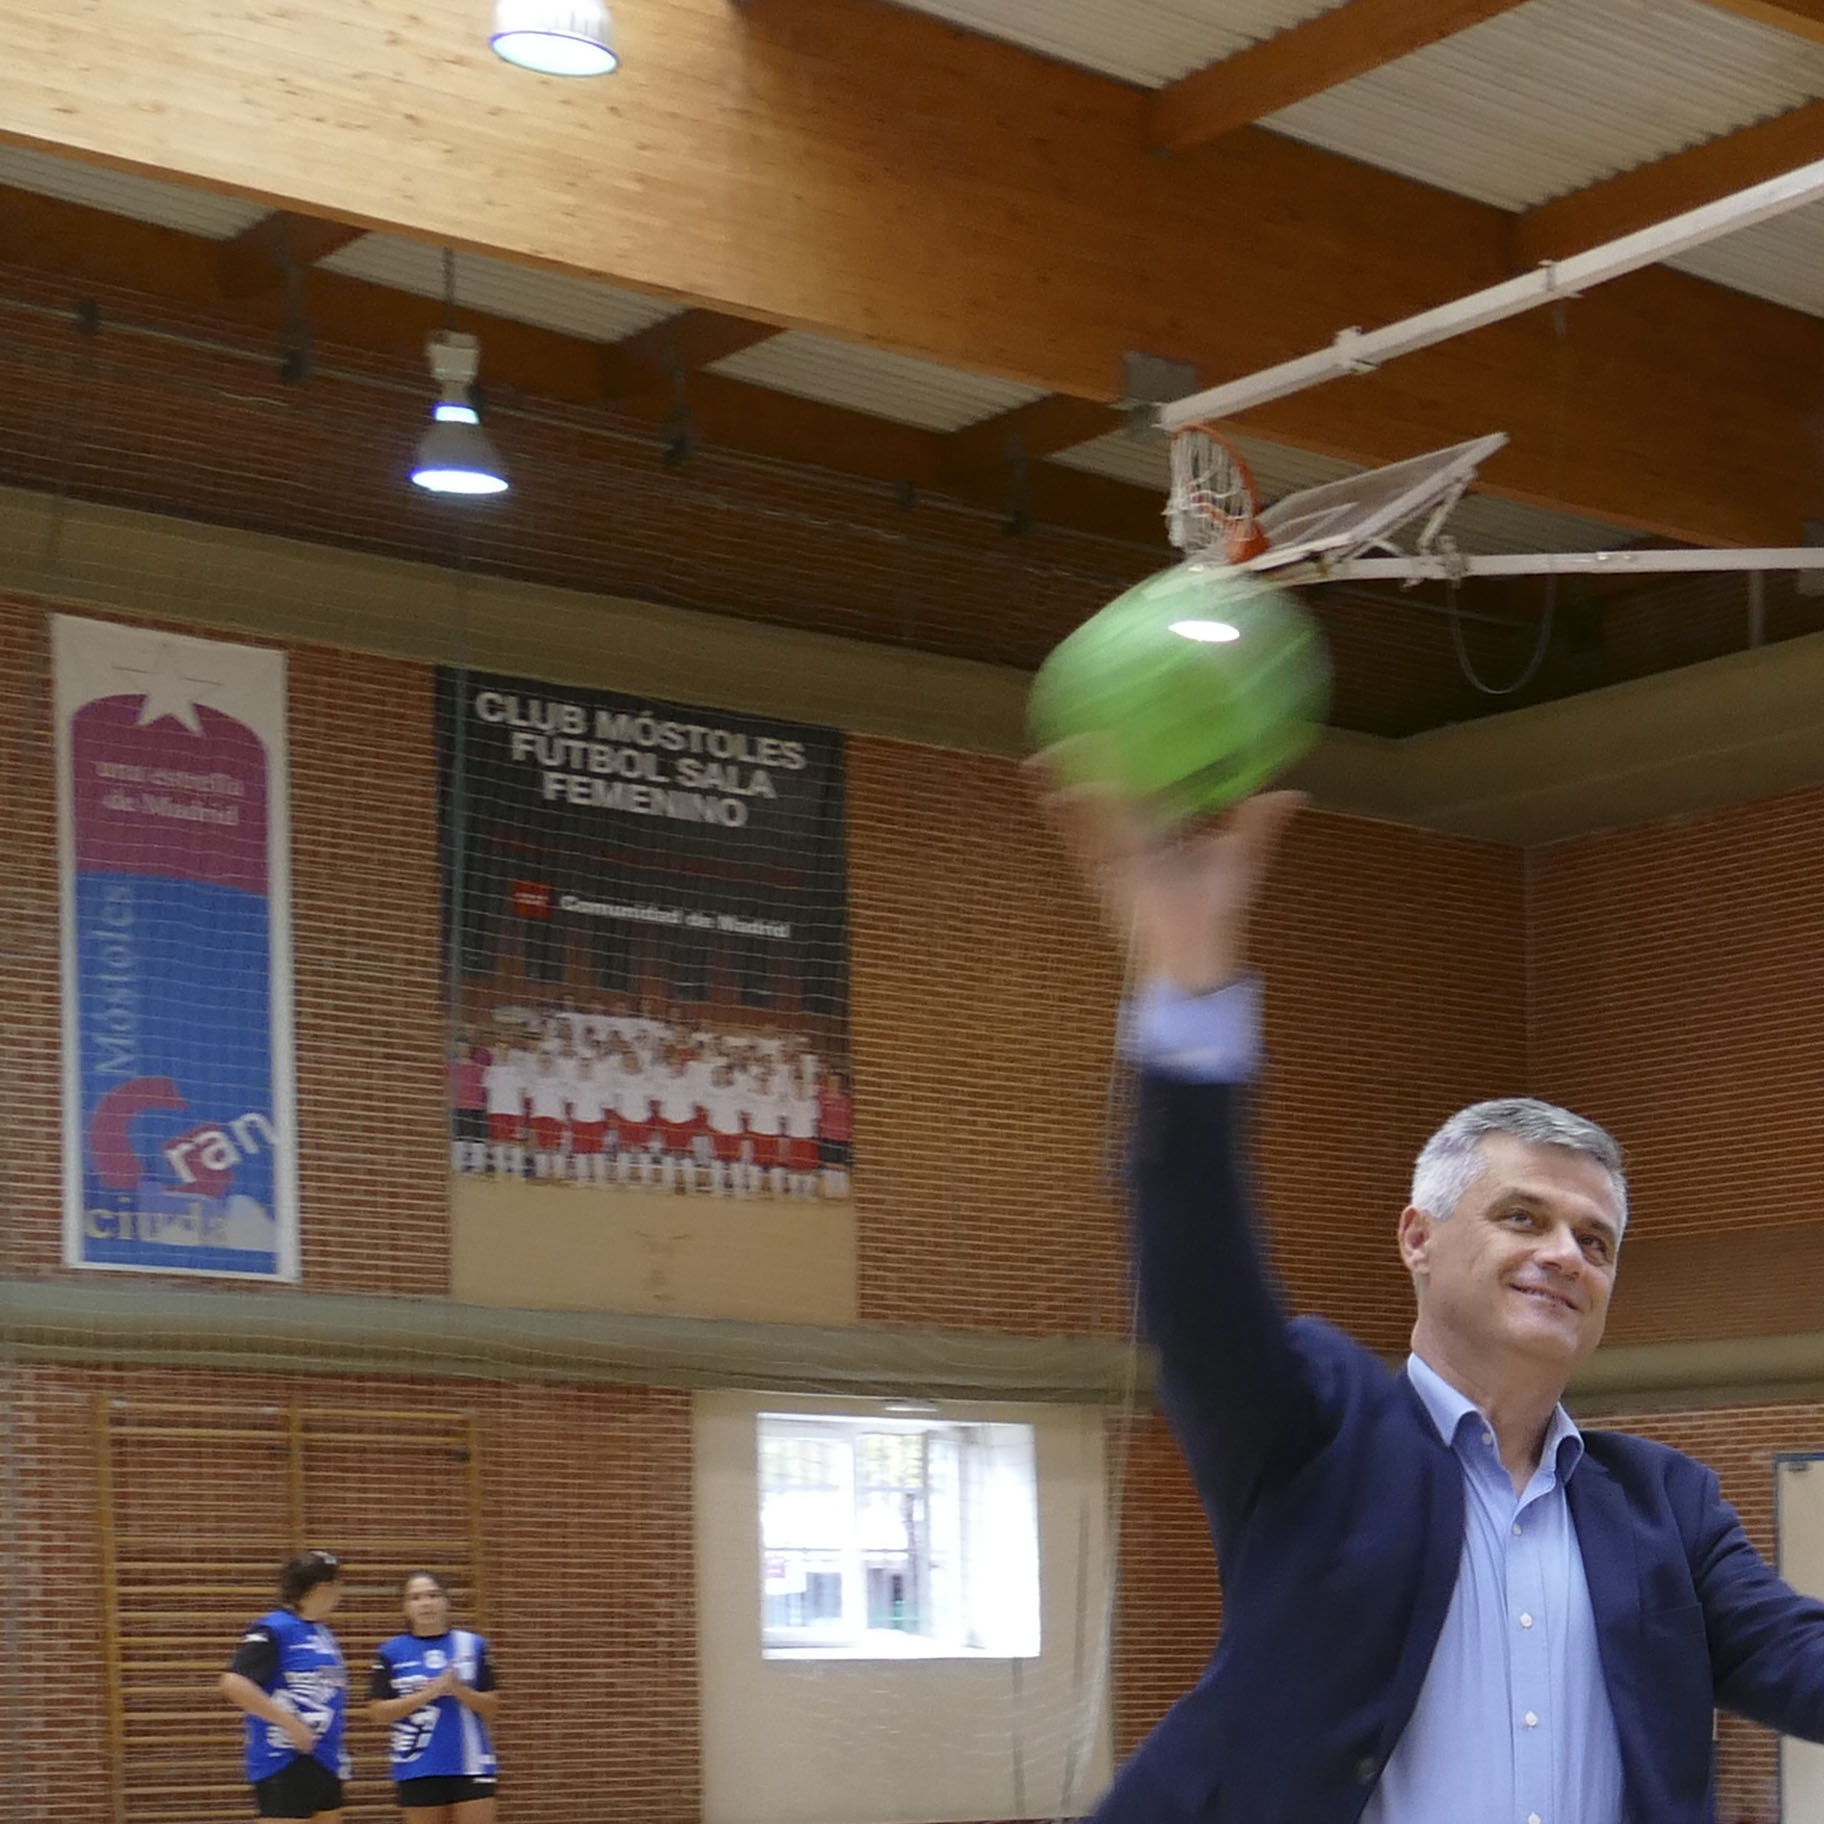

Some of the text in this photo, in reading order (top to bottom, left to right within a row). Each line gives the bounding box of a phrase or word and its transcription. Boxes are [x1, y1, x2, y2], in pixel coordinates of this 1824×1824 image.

[474, 691, 809, 770] CLUB MÓSTOLES
[542, 770, 750, 828] FEMENINO
[675, 757, 777, 800] SALA
